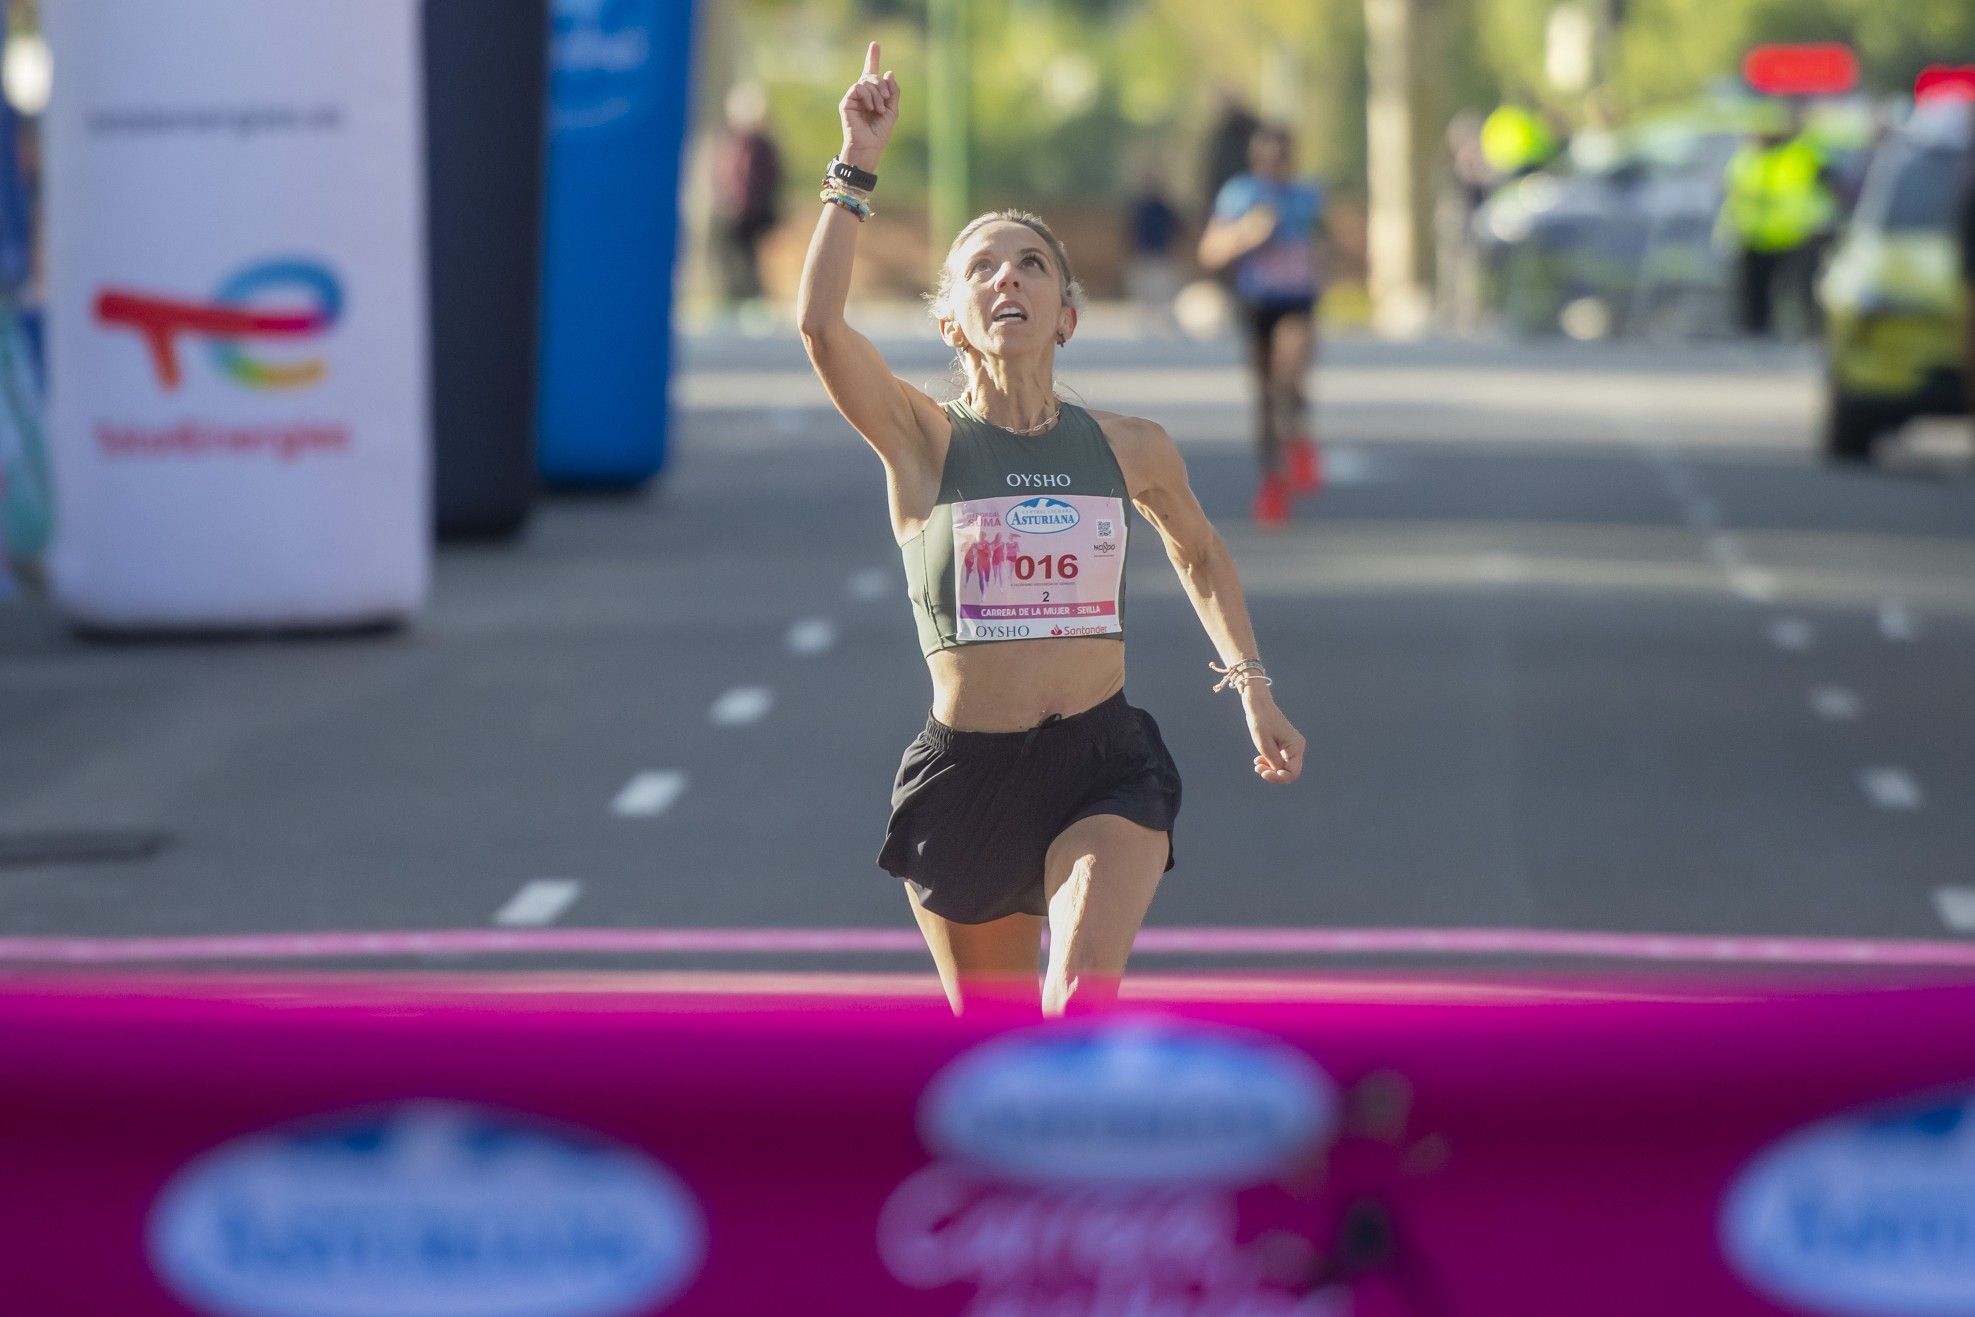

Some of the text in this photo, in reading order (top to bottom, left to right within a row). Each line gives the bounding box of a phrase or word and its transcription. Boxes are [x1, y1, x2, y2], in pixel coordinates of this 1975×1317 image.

[1006, 473, 1071, 487] OYSHO
[1011, 512, 1075, 525] ASTURIANA
[1014, 554, 1079, 580] 016
[1042, 591, 1050, 602] 2
[981, 608, 1017, 617] CARRERA
[1018, 607, 1030, 616] DE
[1031, 607, 1042, 616] LA
[1043, 606, 1070, 615] MUJER
[1076, 604, 1101, 614] SEVILLA
[975, 625, 1030, 638] OYSHO
[1063, 625, 1108, 636] Santander
